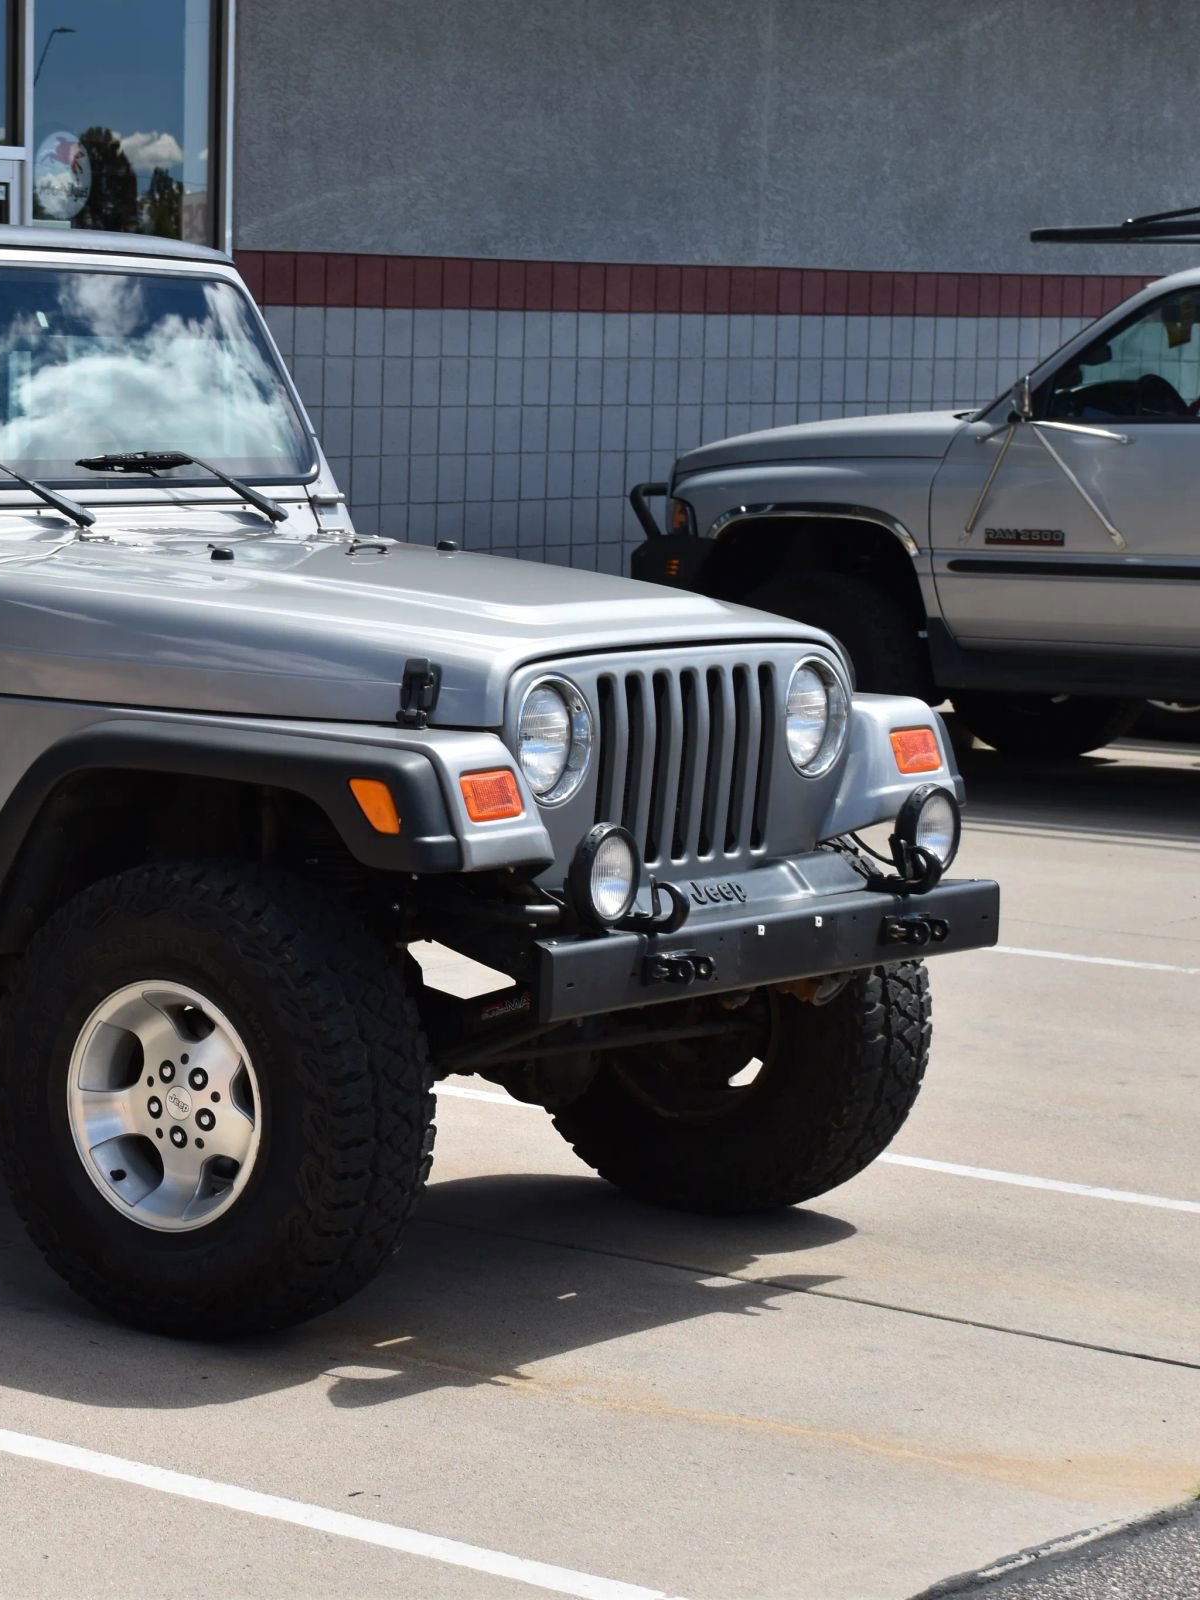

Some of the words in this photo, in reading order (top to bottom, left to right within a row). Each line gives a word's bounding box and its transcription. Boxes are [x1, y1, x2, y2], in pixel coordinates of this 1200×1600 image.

[985, 528, 1017, 541] RAM
[1019, 529, 1063, 542] 2500
[689, 880, 748, 905] Jeep
[168, 1093, 190, 1113] Jeep
